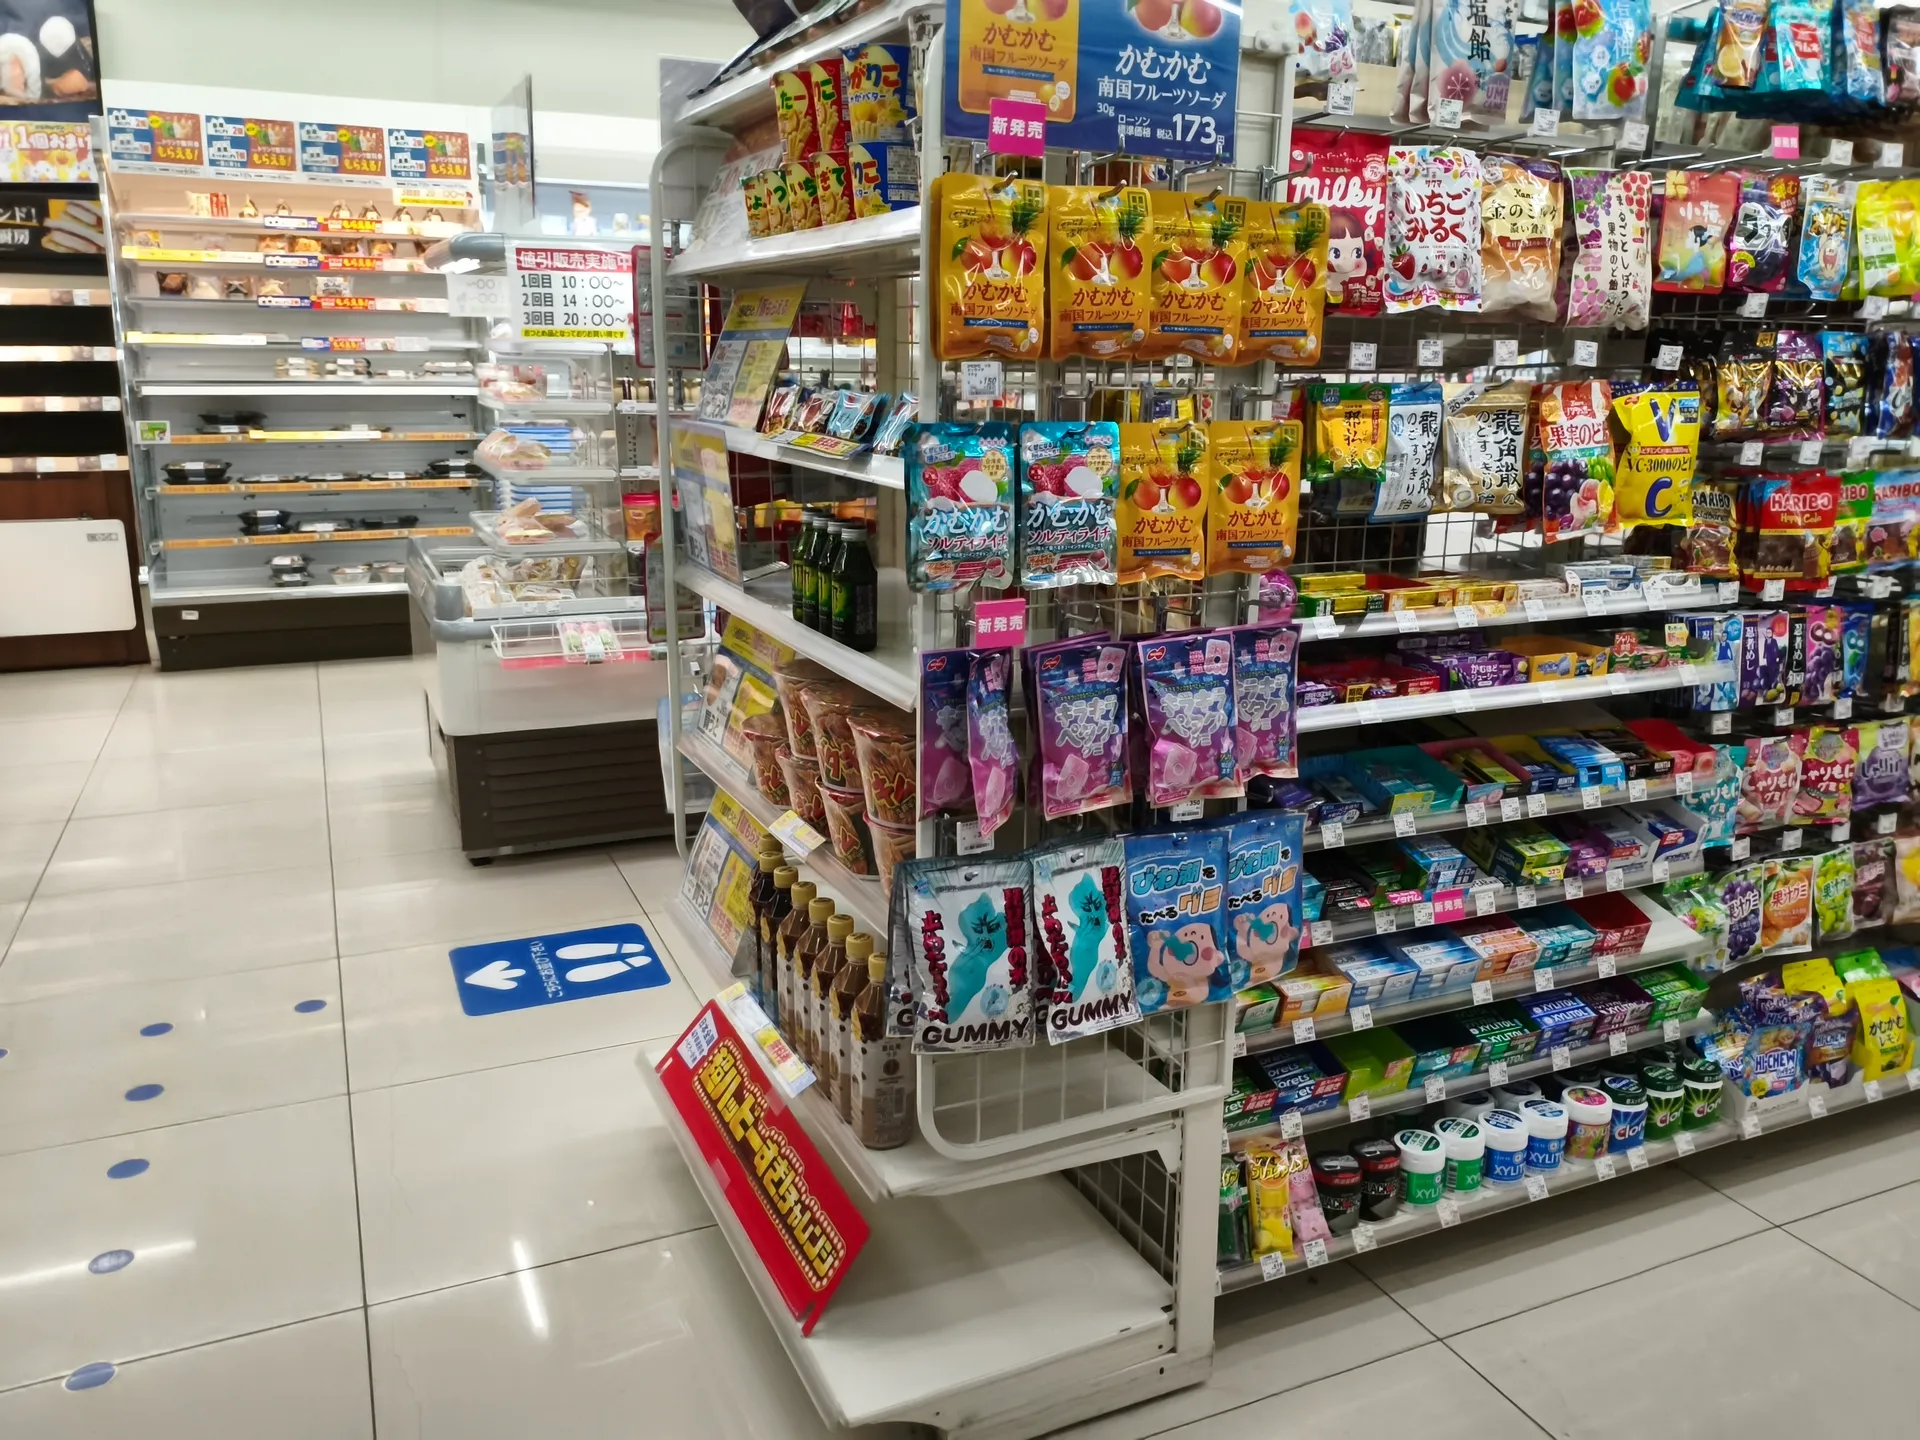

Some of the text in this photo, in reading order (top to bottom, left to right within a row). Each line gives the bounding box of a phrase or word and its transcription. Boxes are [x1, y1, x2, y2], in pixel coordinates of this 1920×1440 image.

[983, 22, 1056, 51] かむかむ
[968, 45, 1070, 72] 南国フルーツソーダ
[1115, 43, 1212, 85] かむかむ
[1096, 74, 1227, 110] 南国フルーツソーダ
[1096, 101, 1116, 117] 30g
[1118, 114, 1151, 126] ローソン
[991, 115, 1044, 140] 新発売
[1173, 112, 1217, 145] 173
[1404, 188, 1472, 216] いちご
[1404, 217, 1469, 244] みるく
[517, 251, 632, 271] 値引販売実施中
[521, 275, 552, 289] 1回目
[963, 281, 1029, 303] かむかむ
[522, 293, 553, 307] 2回目
[1071, 286, 1136, 307] かむかむ
[1160, 290, 1227, 312] かむかむ
[523, 311, 555, 326] 3回目
[1491, 408, 1525, 505] 龍角散の
[1770, 492, 1833, 512] HARIBO
[1839, 484, 1868, 501] RIBO
[923, 502, 1010, 535] かむかむ
[1026, 499, 1111, 529] かむかむ
[1227, 509, 1284, 527] かむかむ
[1028, 527, 1112, 546] ソルティライチ
[1133, 516, 1194, 535] かむかむ
[928, 535, 1009, 552] ソルティライチ
[978, 615, 1024, 634] 新発売
[1139, 885, 1222, 925] たべる グミ
[1770, 883, 1809, 908] 果汁グミ
[1050, 990, 1133, 1031] GUMMY
[921, 1016, 1030, 1046] GUMMY
[1868, 1014, 1906, 1036] かむかむ
[1754, 1048, 1798, 1074] HI-CHEW
